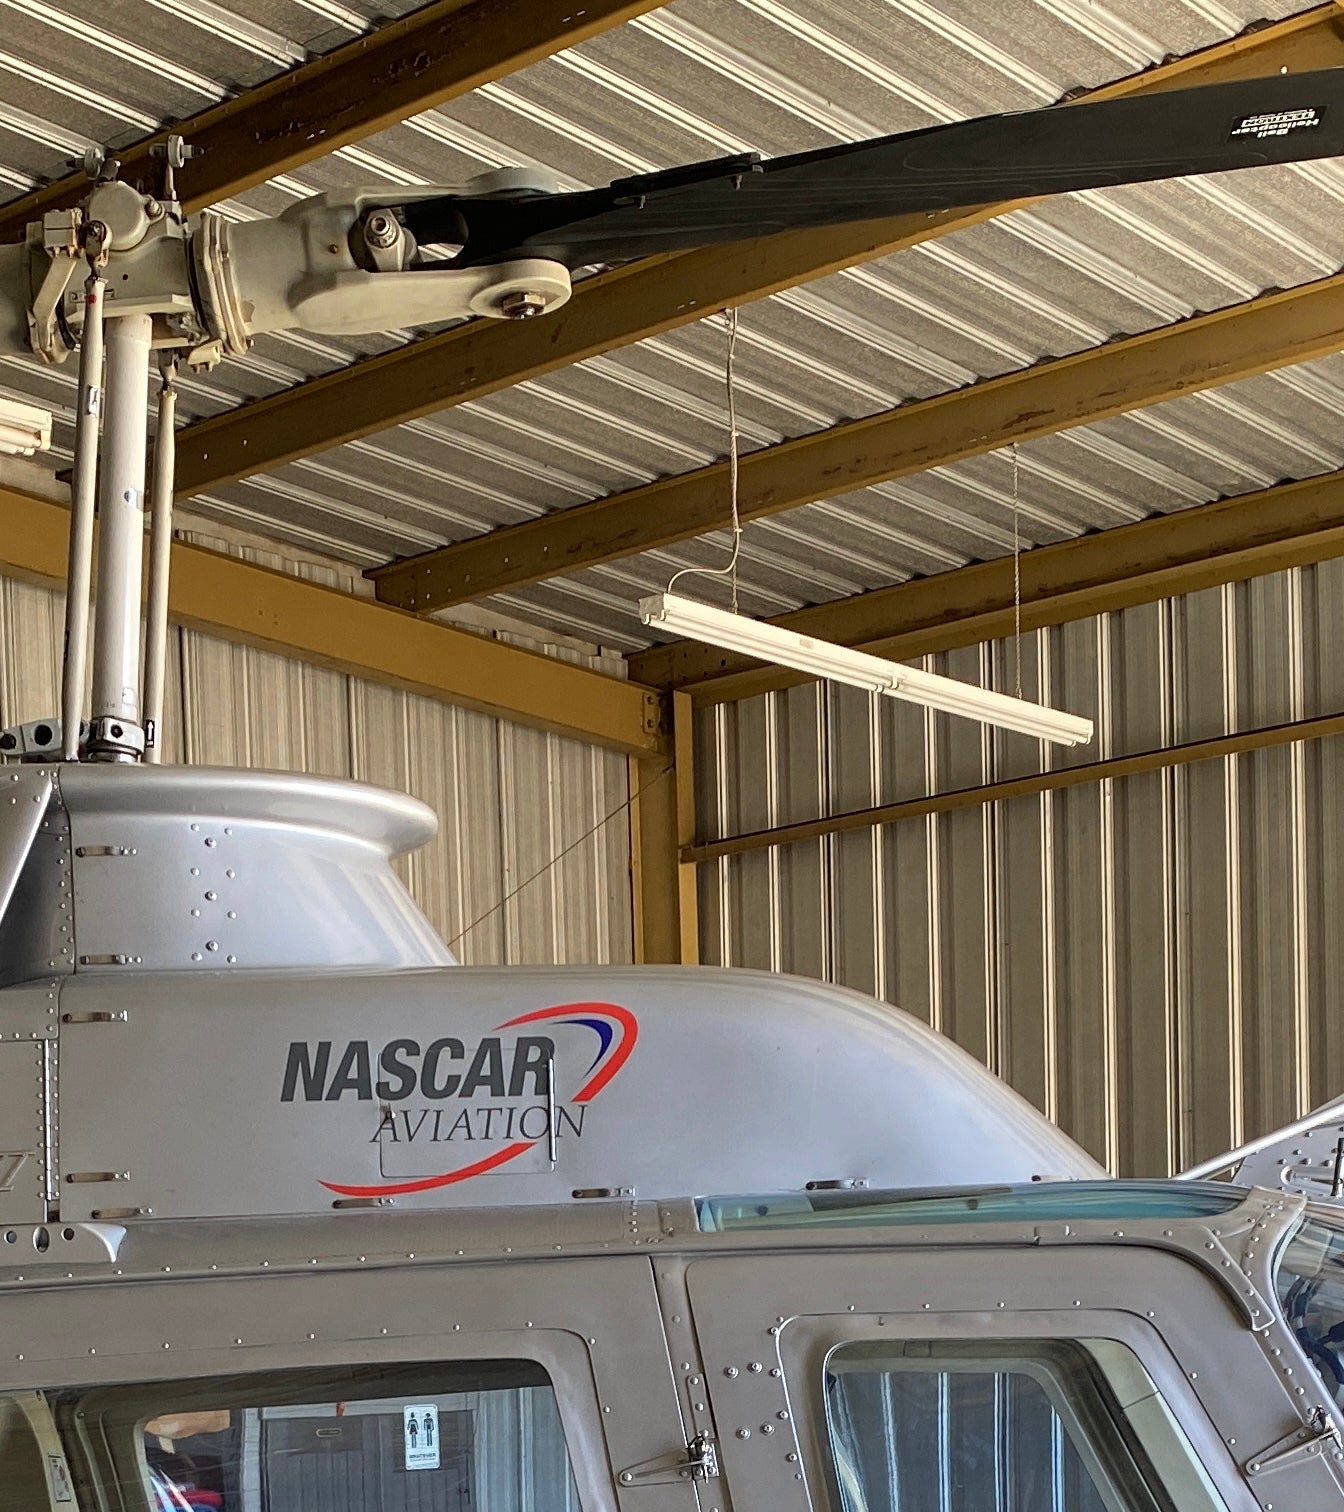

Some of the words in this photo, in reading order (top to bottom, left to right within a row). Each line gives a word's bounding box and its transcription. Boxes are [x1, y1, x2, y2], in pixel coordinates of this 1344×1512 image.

[1232, 118, 1320, 135] Helicopter
[280, 1036, 555, 1102] NASCAR
[369, 1104, 587, 1144] AVIATION
